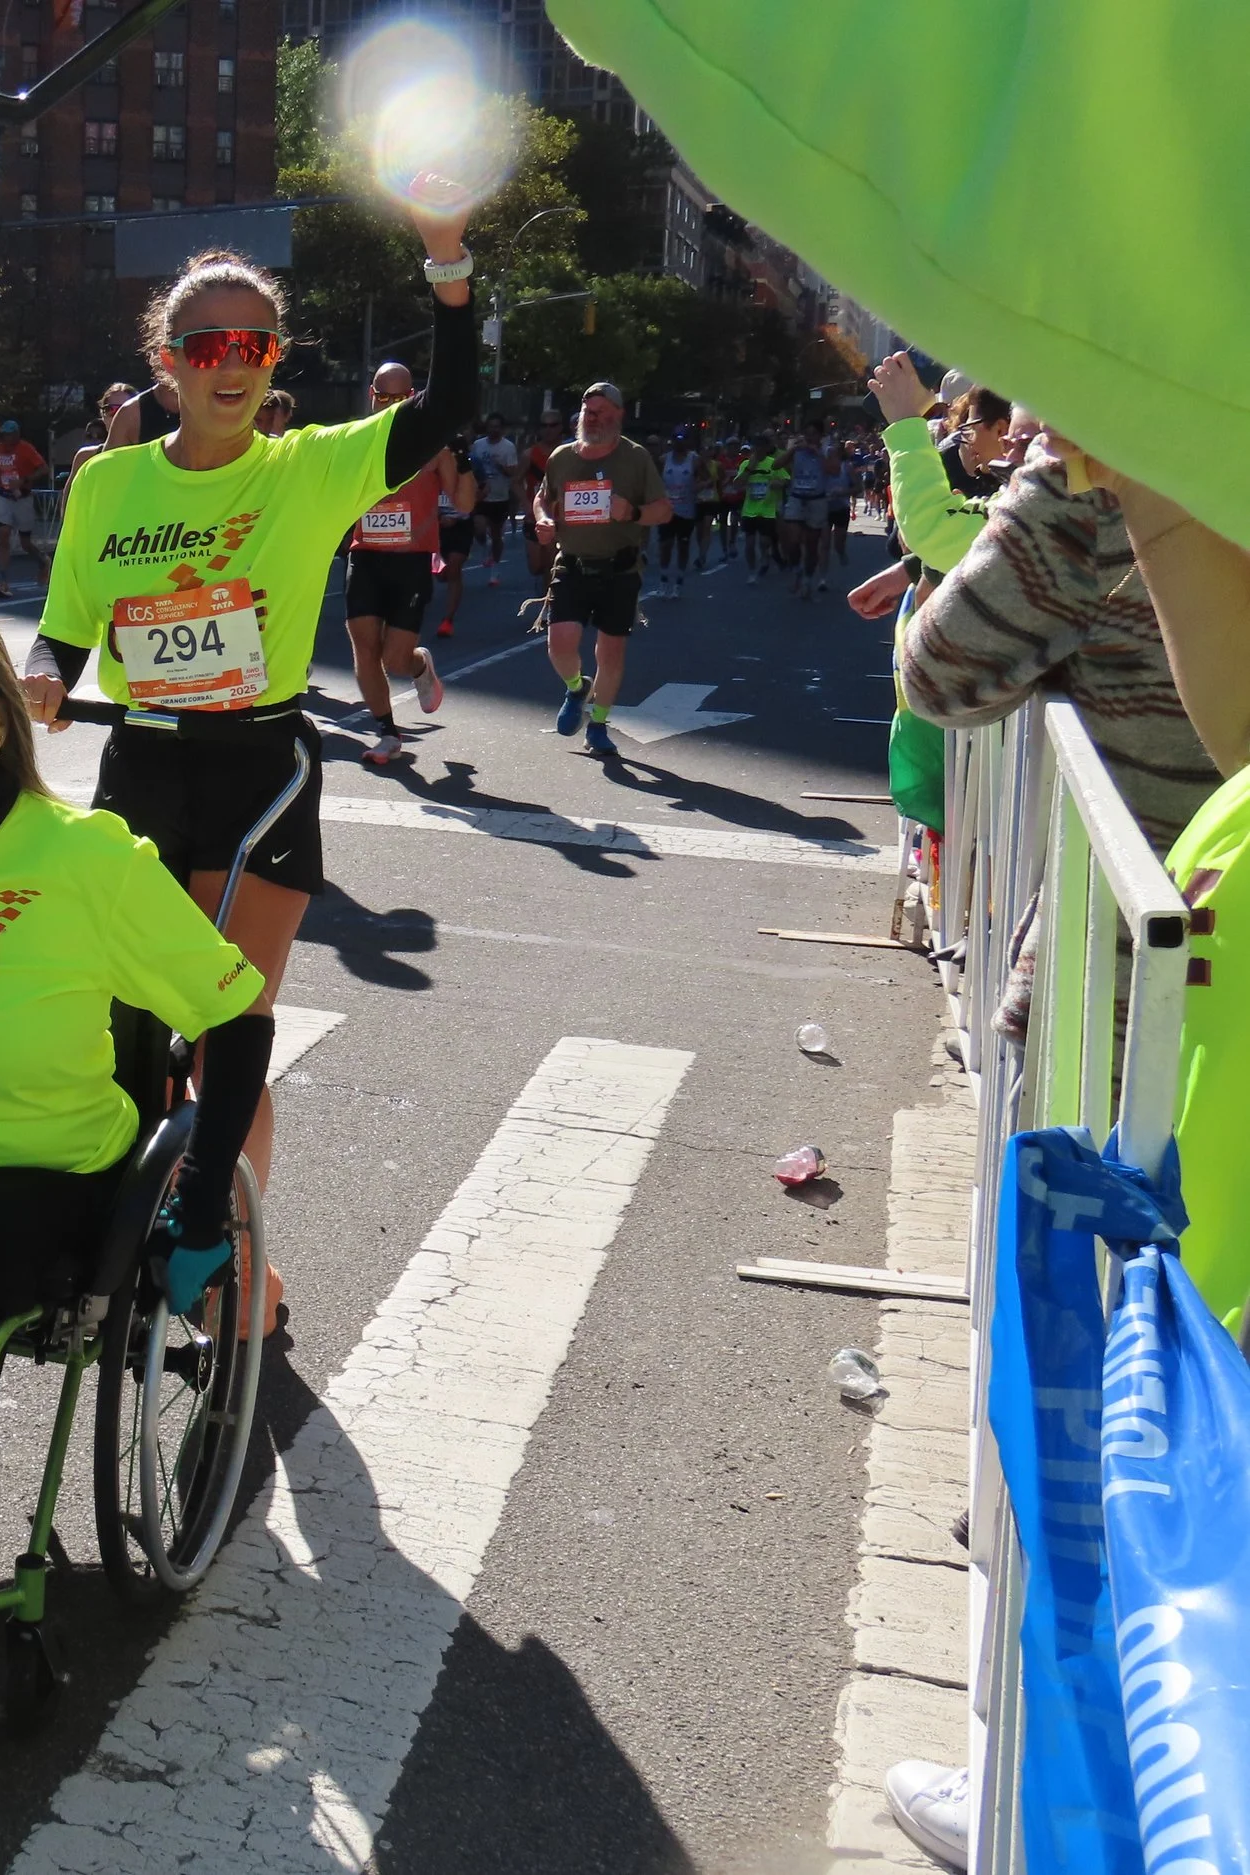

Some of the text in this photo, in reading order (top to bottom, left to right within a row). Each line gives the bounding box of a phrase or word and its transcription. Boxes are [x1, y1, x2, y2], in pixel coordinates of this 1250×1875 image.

[574, 492, 599, 506] 293
[365, 513, 407, 528] 12254
[98, 522, 217, 562] Achilles
[119, 549, 212, 567] INTERNATIONAL
[127, 603, 155, 622] tcs
[156, 602, 199, 614] CONSULTANCY
[210, 600, 235, 611] TATA
[157, 611, 185, 620] SERVICES
[147, 620, 225, 665] 294
[230, 684, 258, 697] 2025
[160, 695, 214, 705] ORANGE CORRAL
